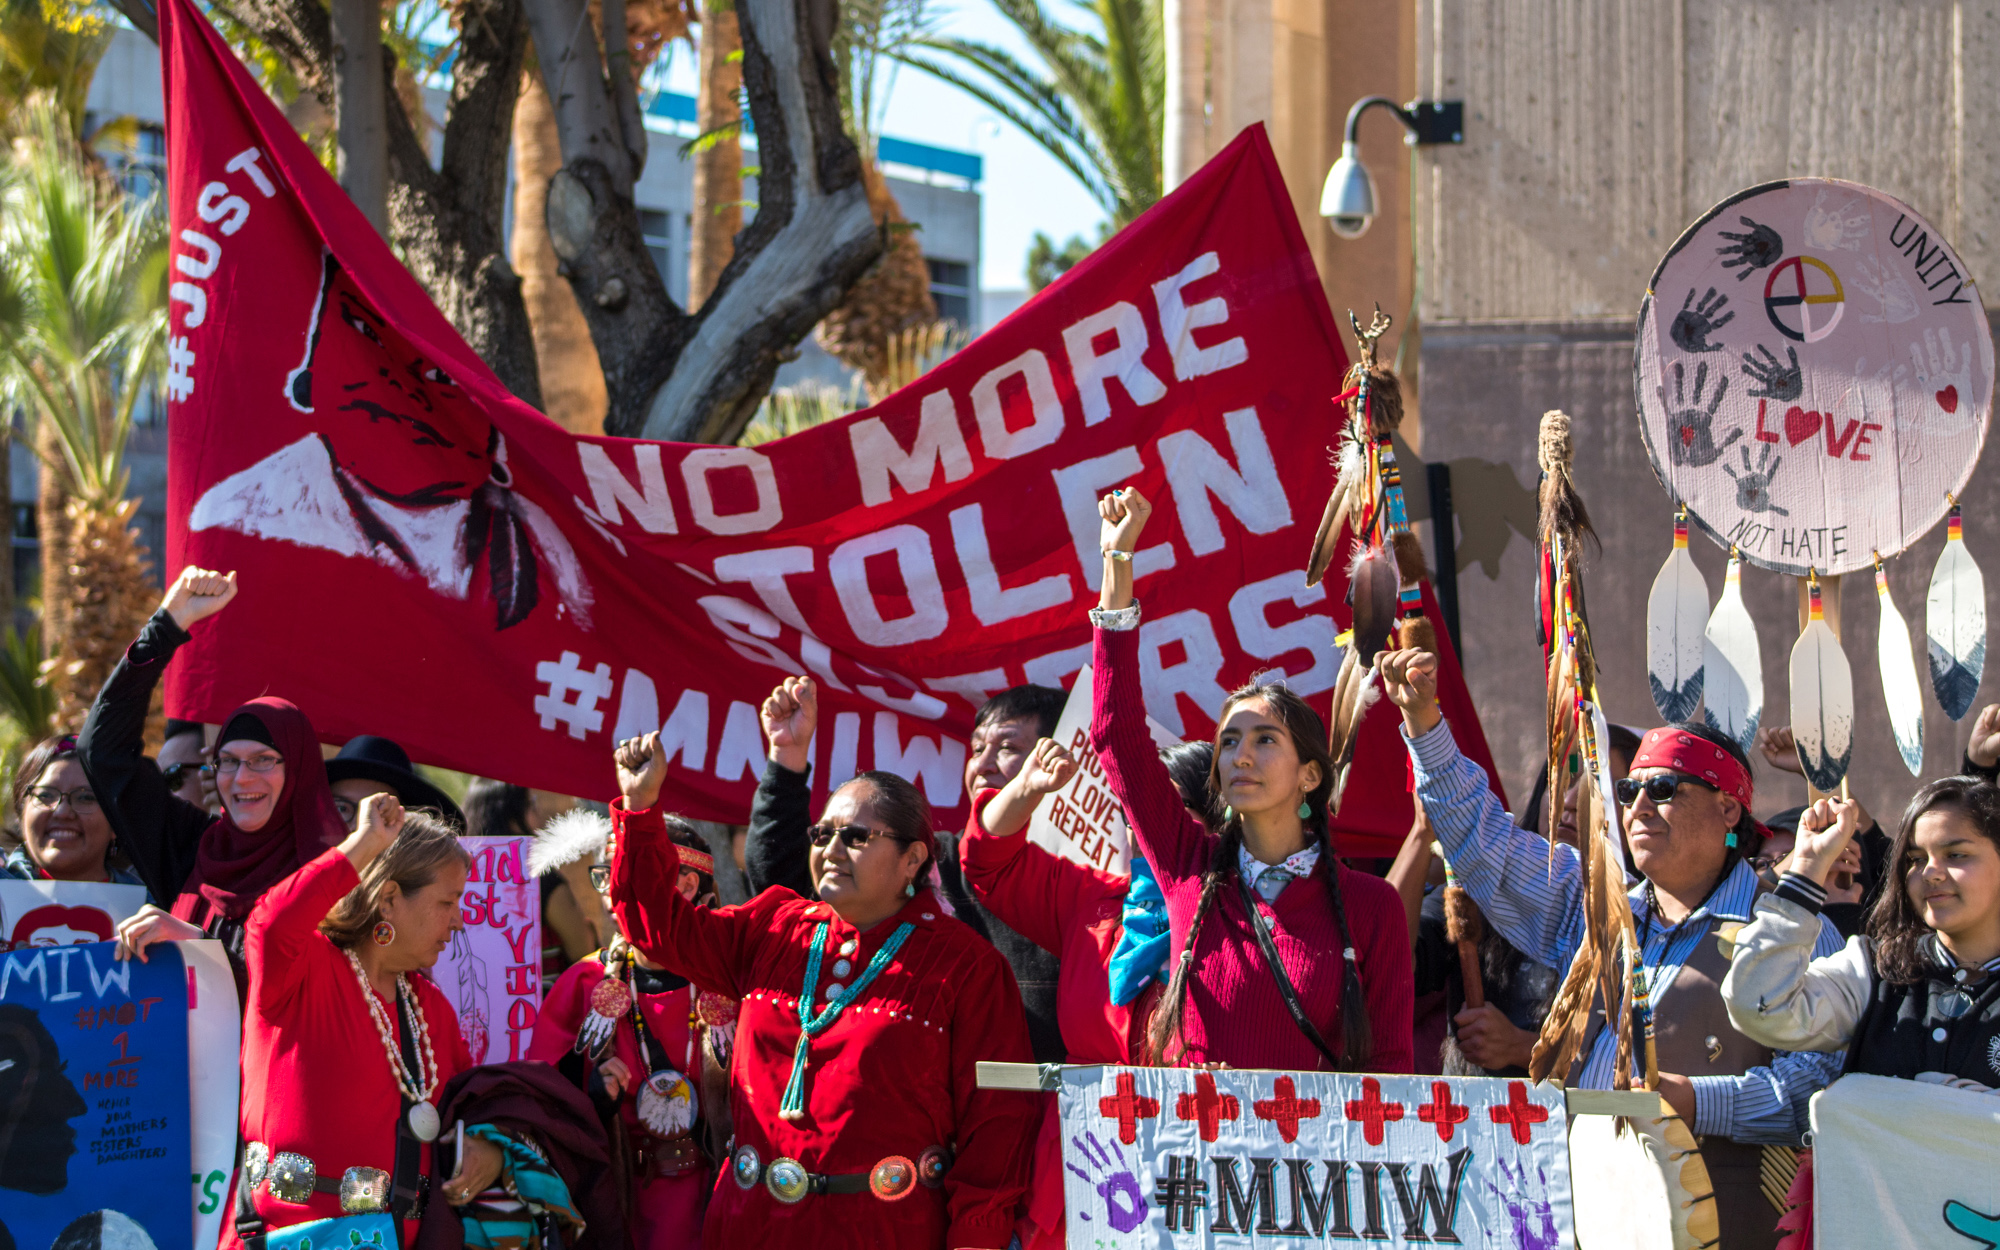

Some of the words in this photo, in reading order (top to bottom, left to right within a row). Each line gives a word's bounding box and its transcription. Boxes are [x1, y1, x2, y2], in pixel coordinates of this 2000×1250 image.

[1888, 213, 1972, 306] UNITY
[576, 441, 783, 536] NO
[849, 251, 1249, 508] MORE
[640, 405, 1294, 648] TOLEN
[1725, 516, 1775, 554] NOT
[1781, 525, 1848, 558] HATE
[1069, 772, 1121, 836] LOVE
[1049, 794, 1120, 872] REPEAT
[72, 997, 164, 1030] #NOT
[1287, 997, 1304, 1020] SONY
[108, 1031, 143, 1067] 1
[83, 1068, 140, 1091] MORE
[90, 1135, 143, 1153] SISTERS
[101, 1116, 168, 1138] MOTHERS
[1154, 1146, 1474, 1245] #MMIW
